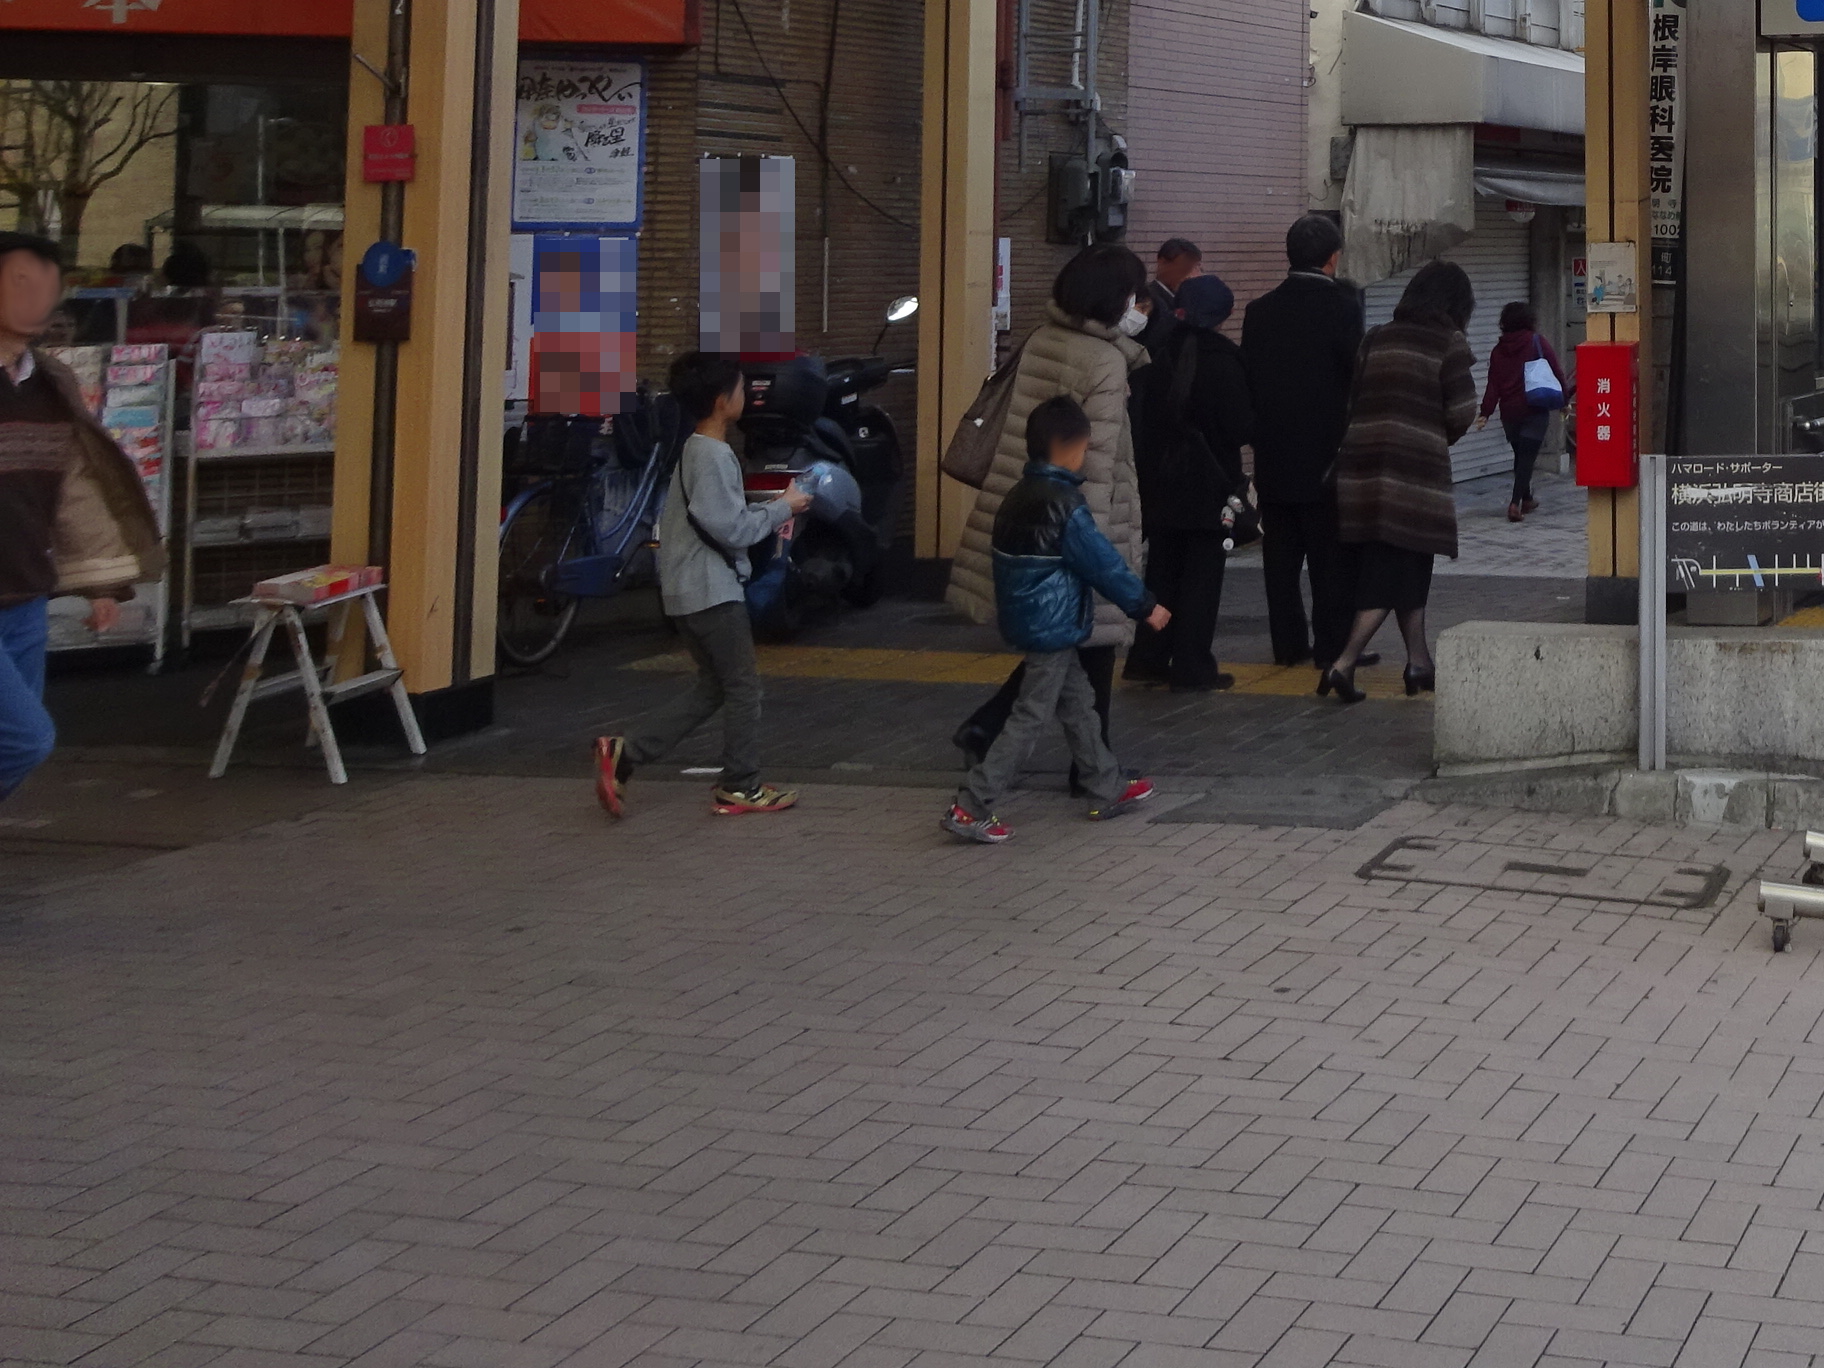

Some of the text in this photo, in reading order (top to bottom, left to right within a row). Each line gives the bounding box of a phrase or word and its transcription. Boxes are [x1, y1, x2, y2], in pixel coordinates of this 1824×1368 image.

[1650, 13, 1680, 195] 根岸眼科医院
[1596, 377, 1611, 441] 消火器
[1671, 461, 1783, 475] ハマロード・サポーター
